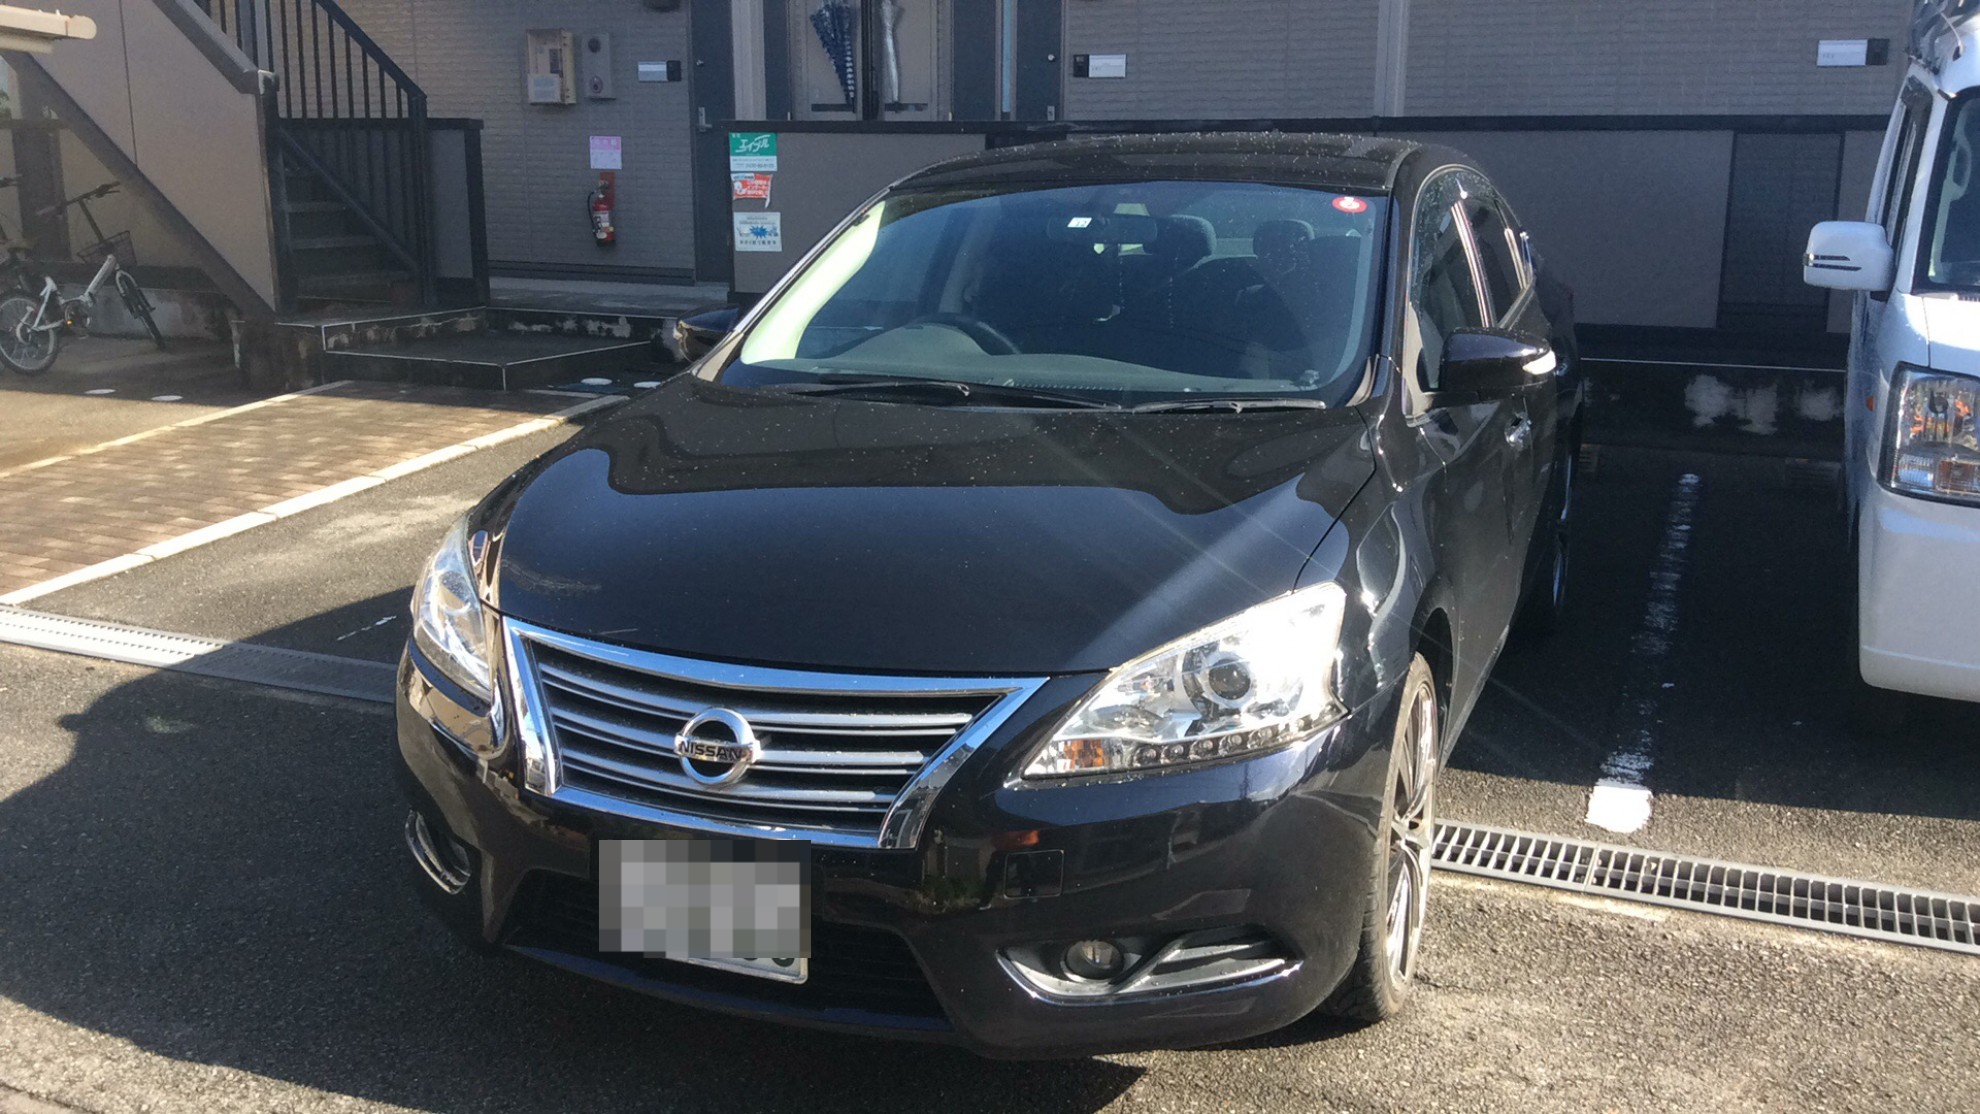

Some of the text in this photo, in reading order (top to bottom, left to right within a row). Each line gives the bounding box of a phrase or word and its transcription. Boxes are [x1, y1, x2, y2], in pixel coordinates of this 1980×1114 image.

[735, 134, 771, 153] エイブル
[680, 740, 743, 760] NISSAN
